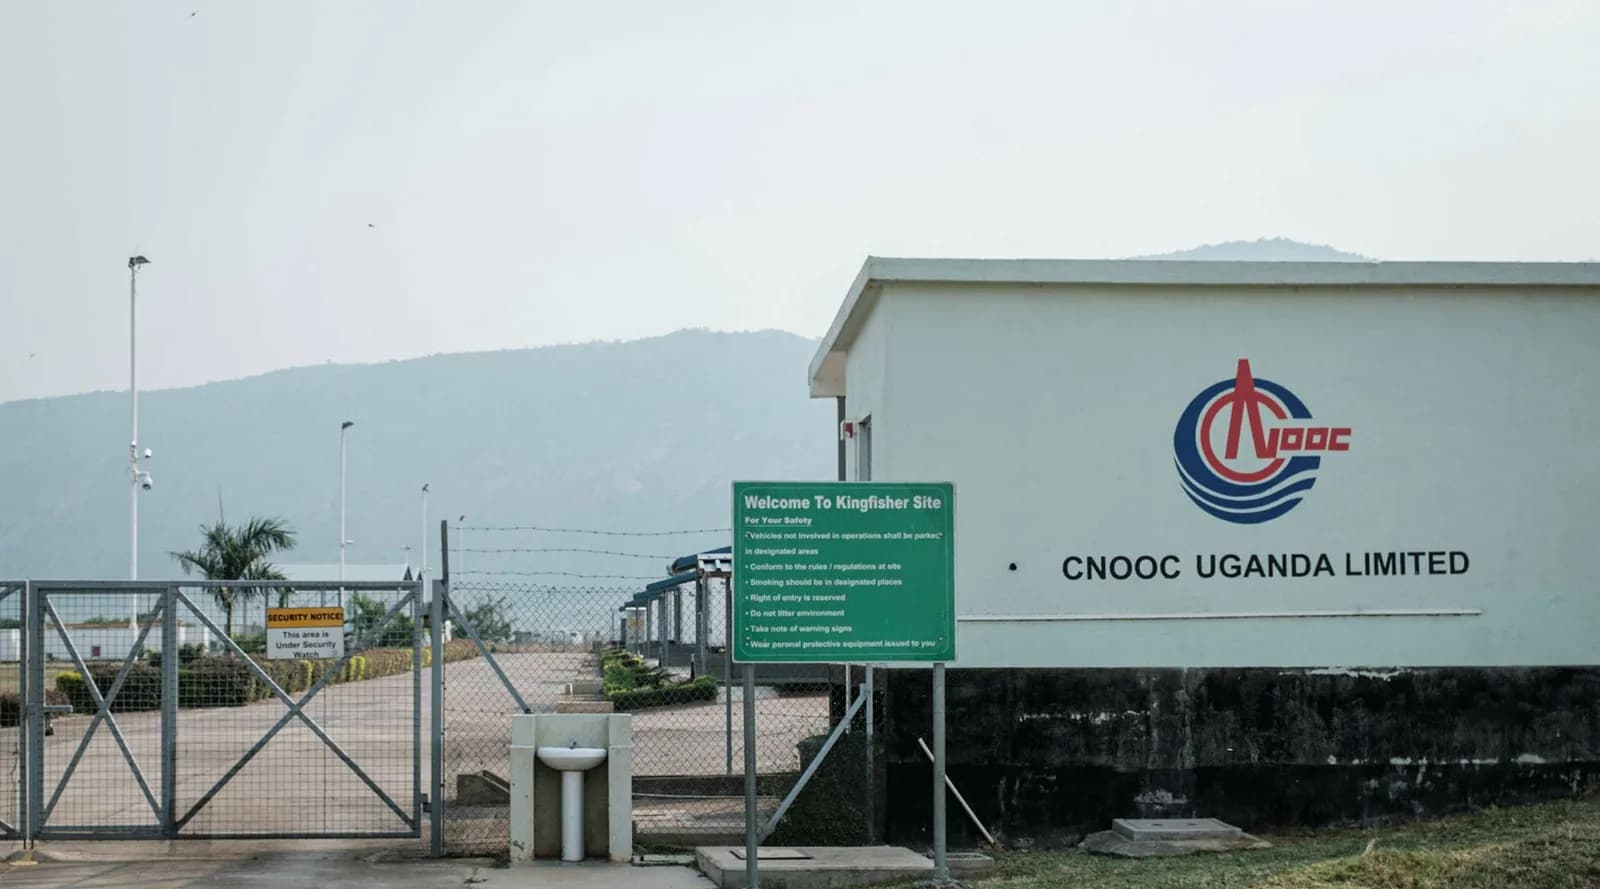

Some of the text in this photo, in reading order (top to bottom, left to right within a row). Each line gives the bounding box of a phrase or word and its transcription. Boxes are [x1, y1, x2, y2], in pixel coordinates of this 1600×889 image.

[744, 495, 941, 512] Welcome To Kingfisher Site
[784, 517, 812, 526] Safety
[841, 533, 881, 541] operations
[754, 547, 797, 556] designated
[834, 563, 876, 572] regulations
[1062, 551, 1470, 580] CNOOC UGANDA LIMITED
[750, 579, 784, 587] Smoking
[834, 579, 876, 587] designated
[877, 579, 902, 587] places
[750, 594, 771, 602] Right
[782, 594, 801, 602] entry
[303, 640, 336, 649] Security
